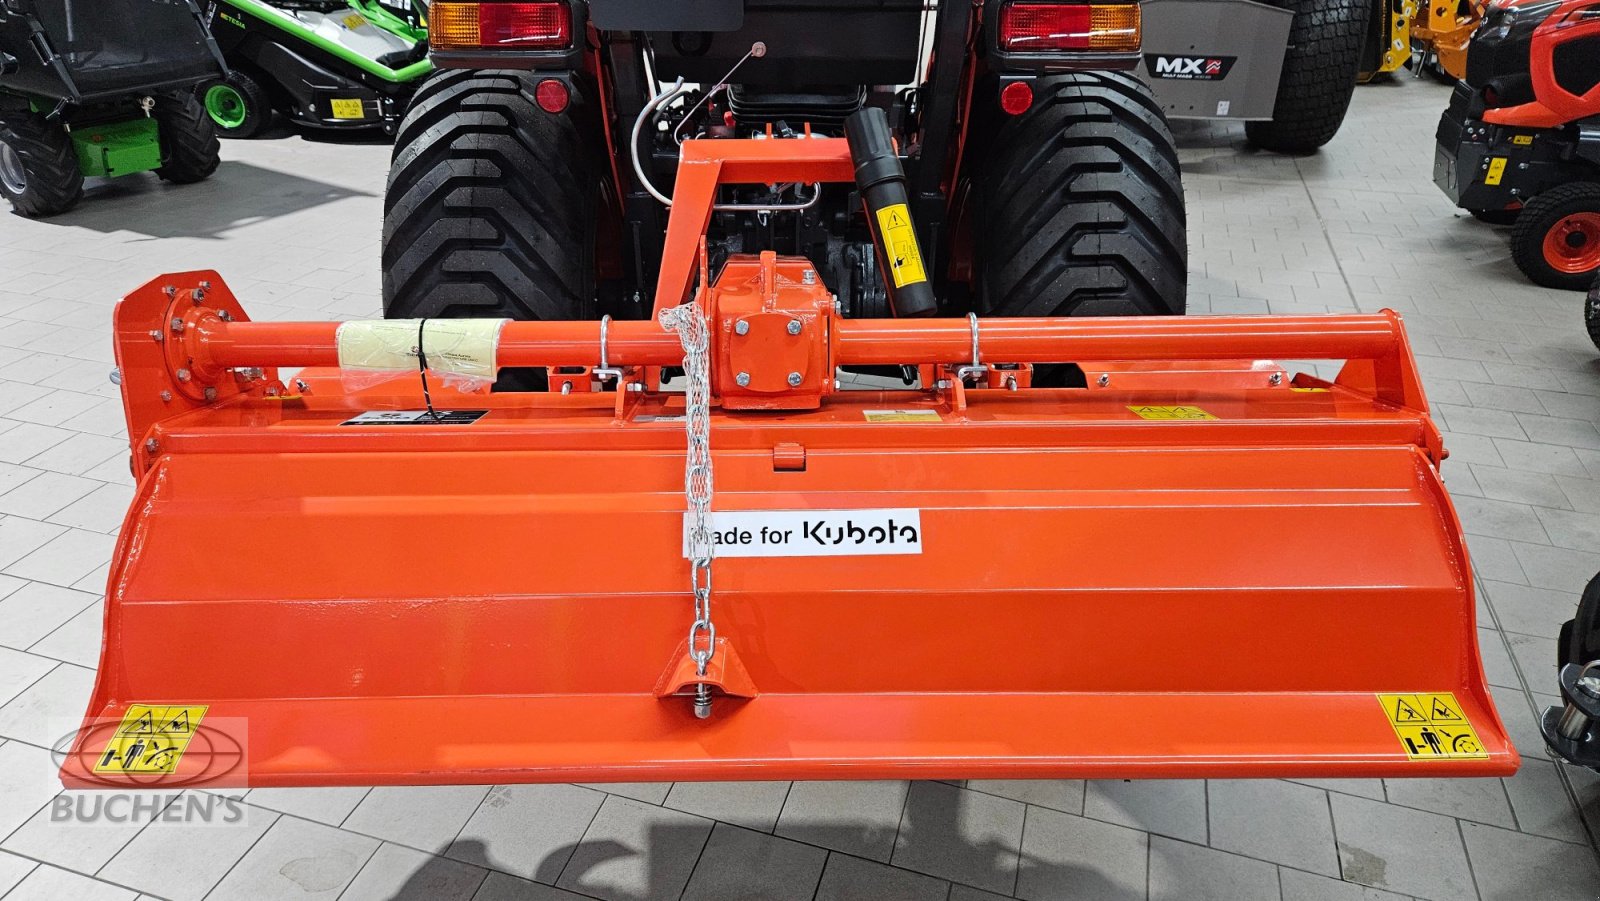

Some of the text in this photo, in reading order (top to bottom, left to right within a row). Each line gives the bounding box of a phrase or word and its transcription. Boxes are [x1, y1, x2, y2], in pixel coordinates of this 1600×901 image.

[1156, 57, 1205, 74] MX
[691, 519, 918, 545] ade for Kubota
